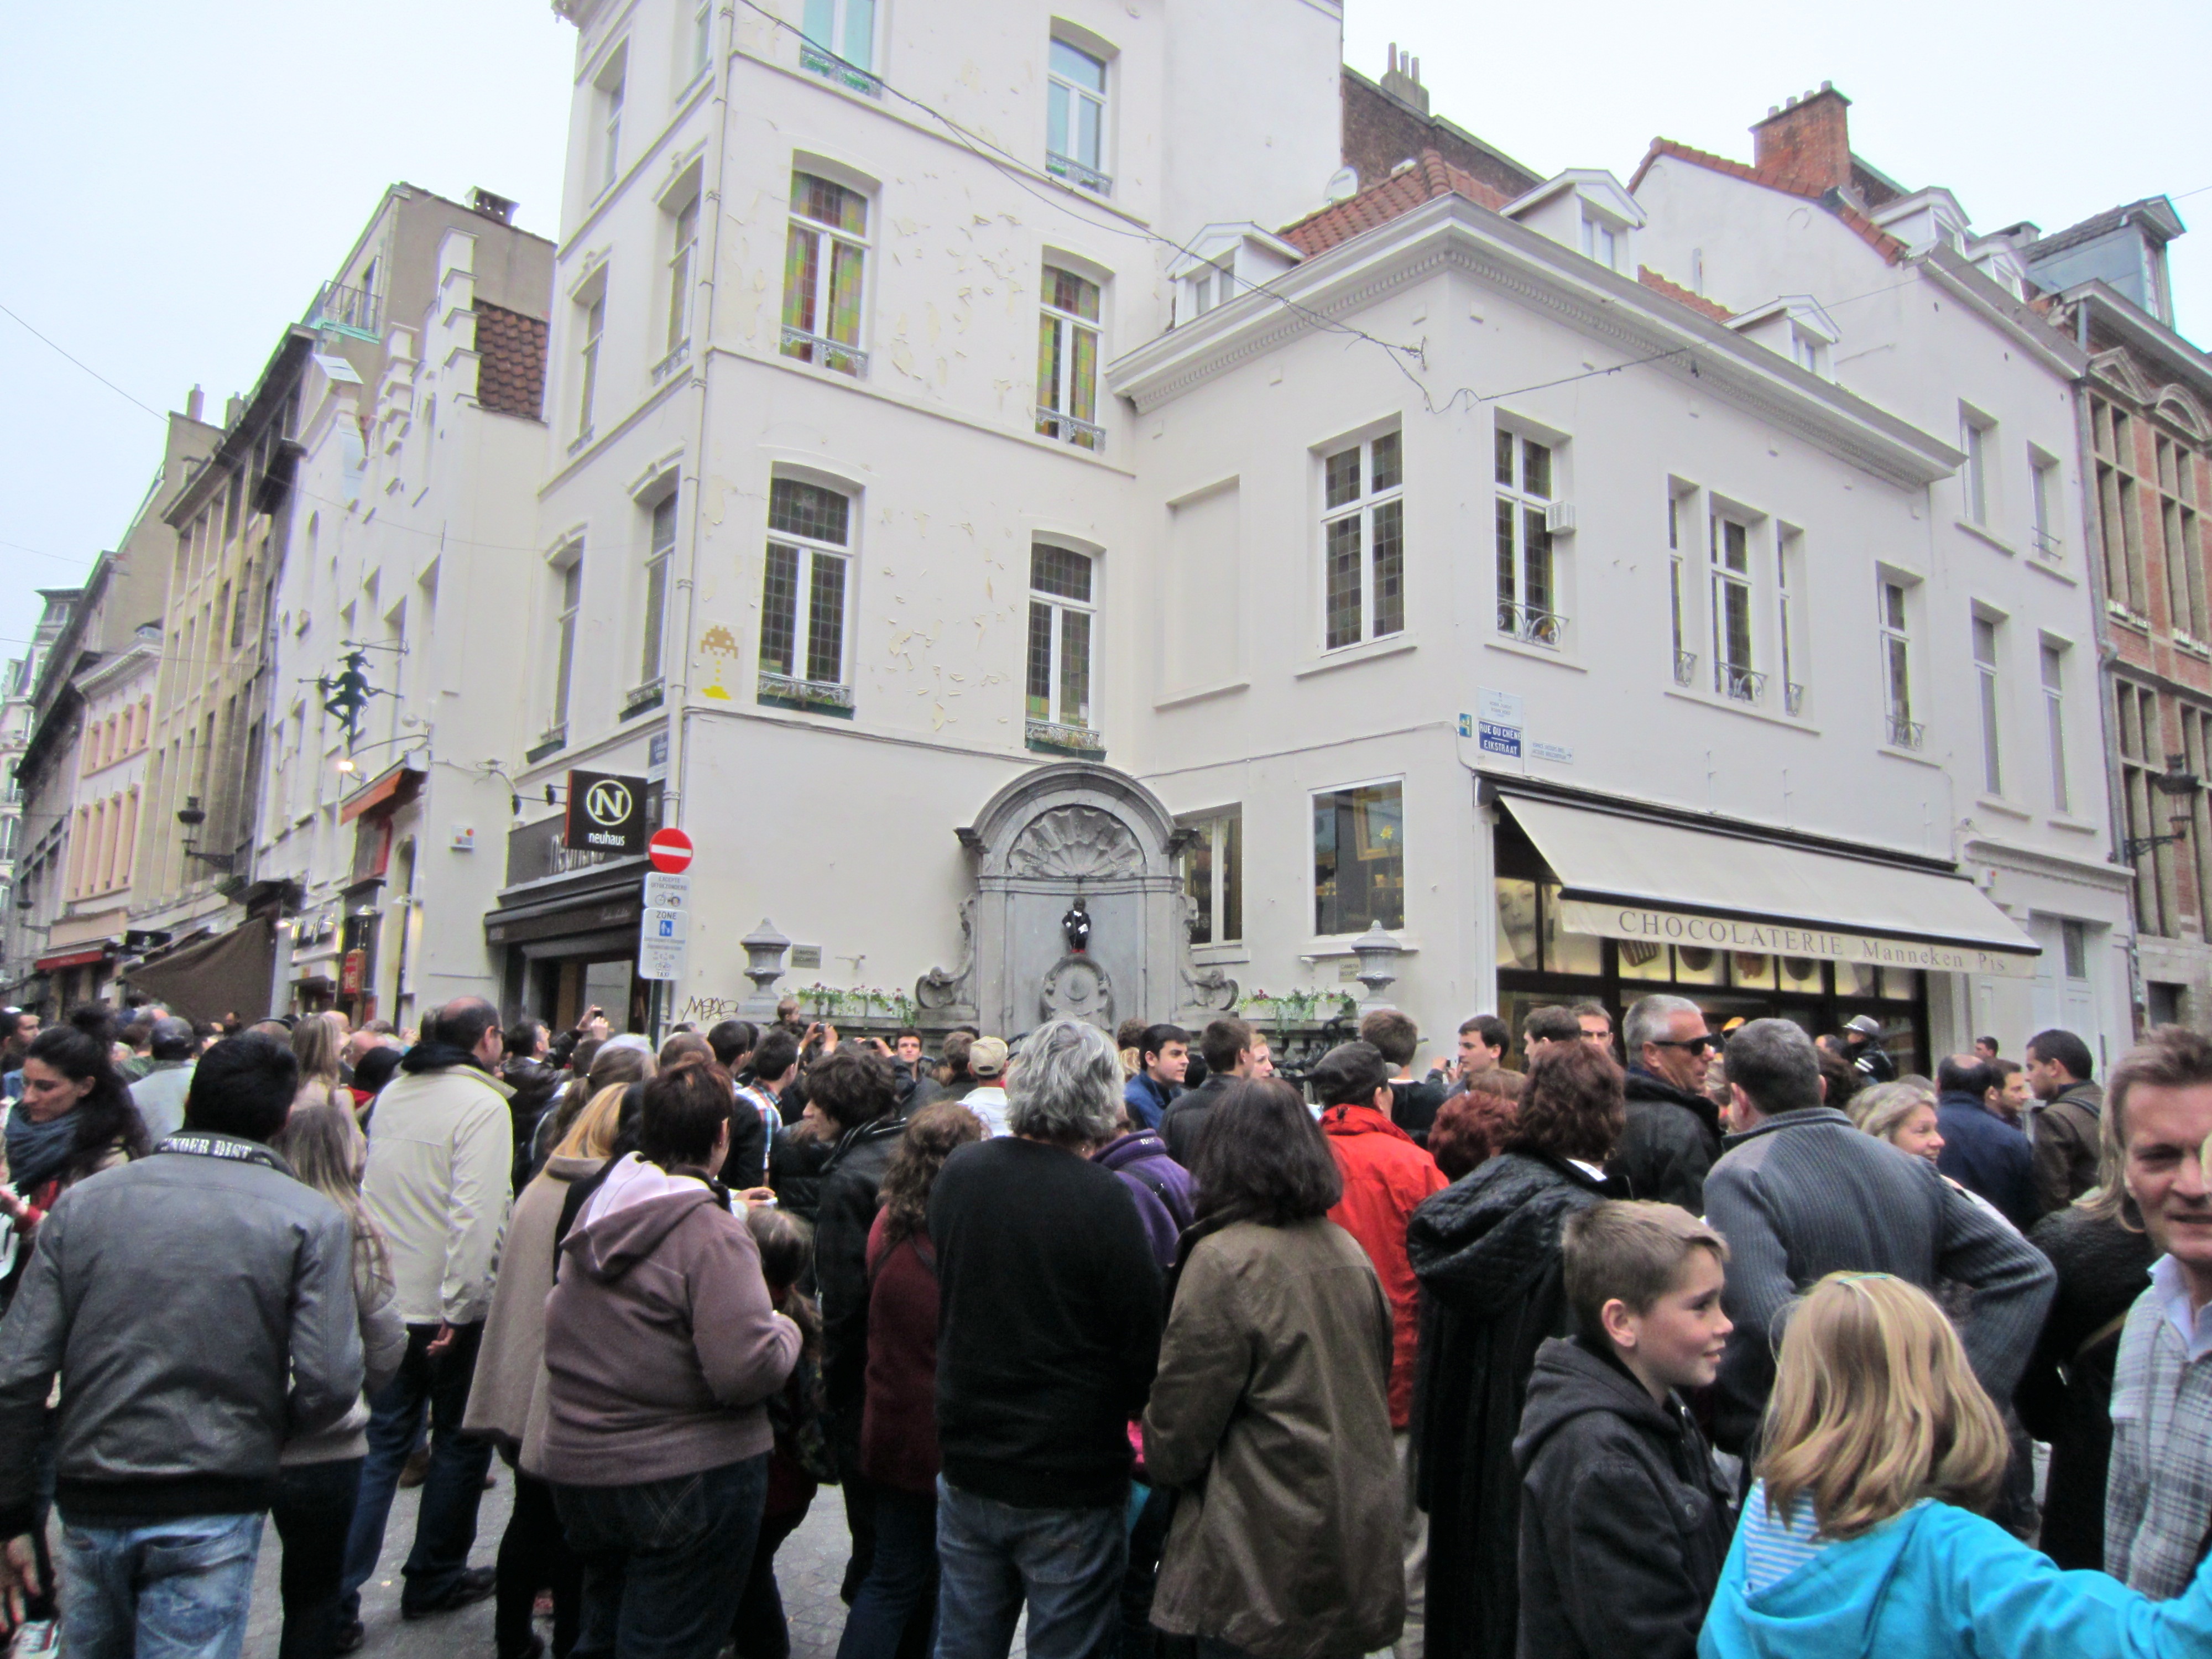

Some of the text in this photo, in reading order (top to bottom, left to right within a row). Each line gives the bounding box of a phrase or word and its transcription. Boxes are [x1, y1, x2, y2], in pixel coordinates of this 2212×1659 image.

[1479, 723, 1492, 734] RUE
[1493, 727, 1501, 736] DU
[1484, 740, 1517, 755] EIKSTRAAT
[594, 789, 624, 817] N
[588, 831, 625, 846] neuhaus
[656, 911, 676, 920] ZONE
[1619, 910, 2005, 971] CHOCOLATERIE Manneken Pis
